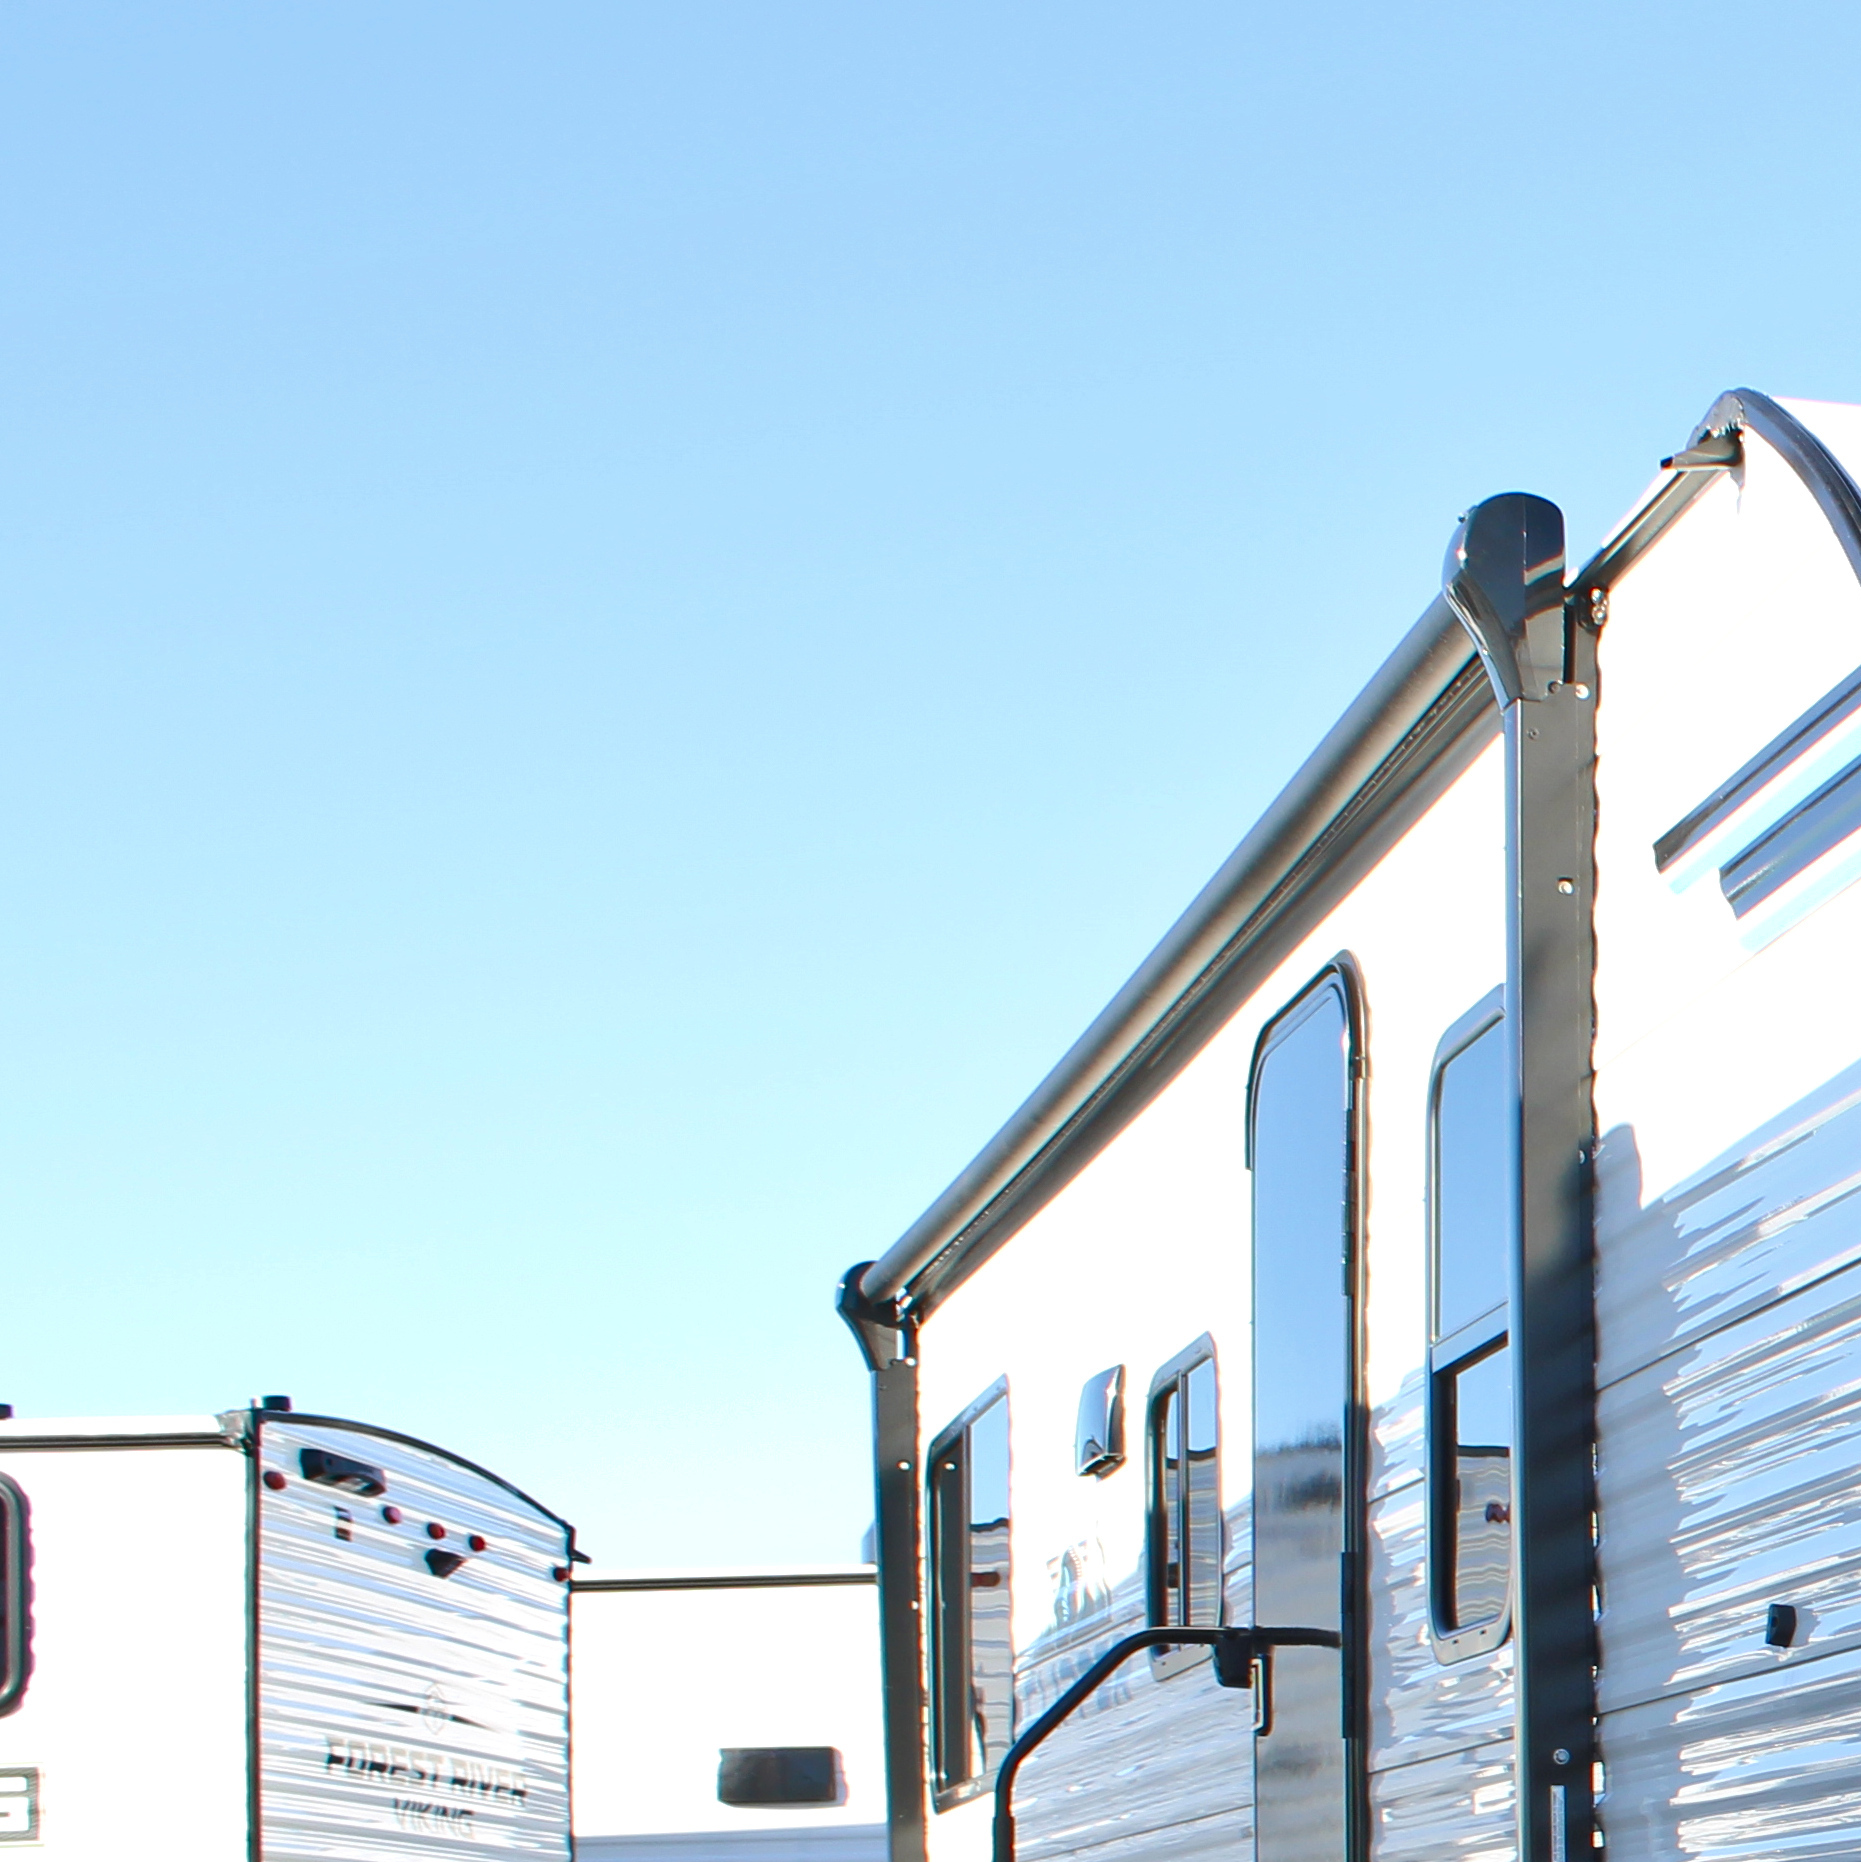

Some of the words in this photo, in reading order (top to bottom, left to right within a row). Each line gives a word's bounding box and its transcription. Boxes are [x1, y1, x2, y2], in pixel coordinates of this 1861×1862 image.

[325, 1734, 445, 1790] FOREST
[449, 1757, 528, 1808] RIVER
[392, 1797, 476, 1840] VIKING
